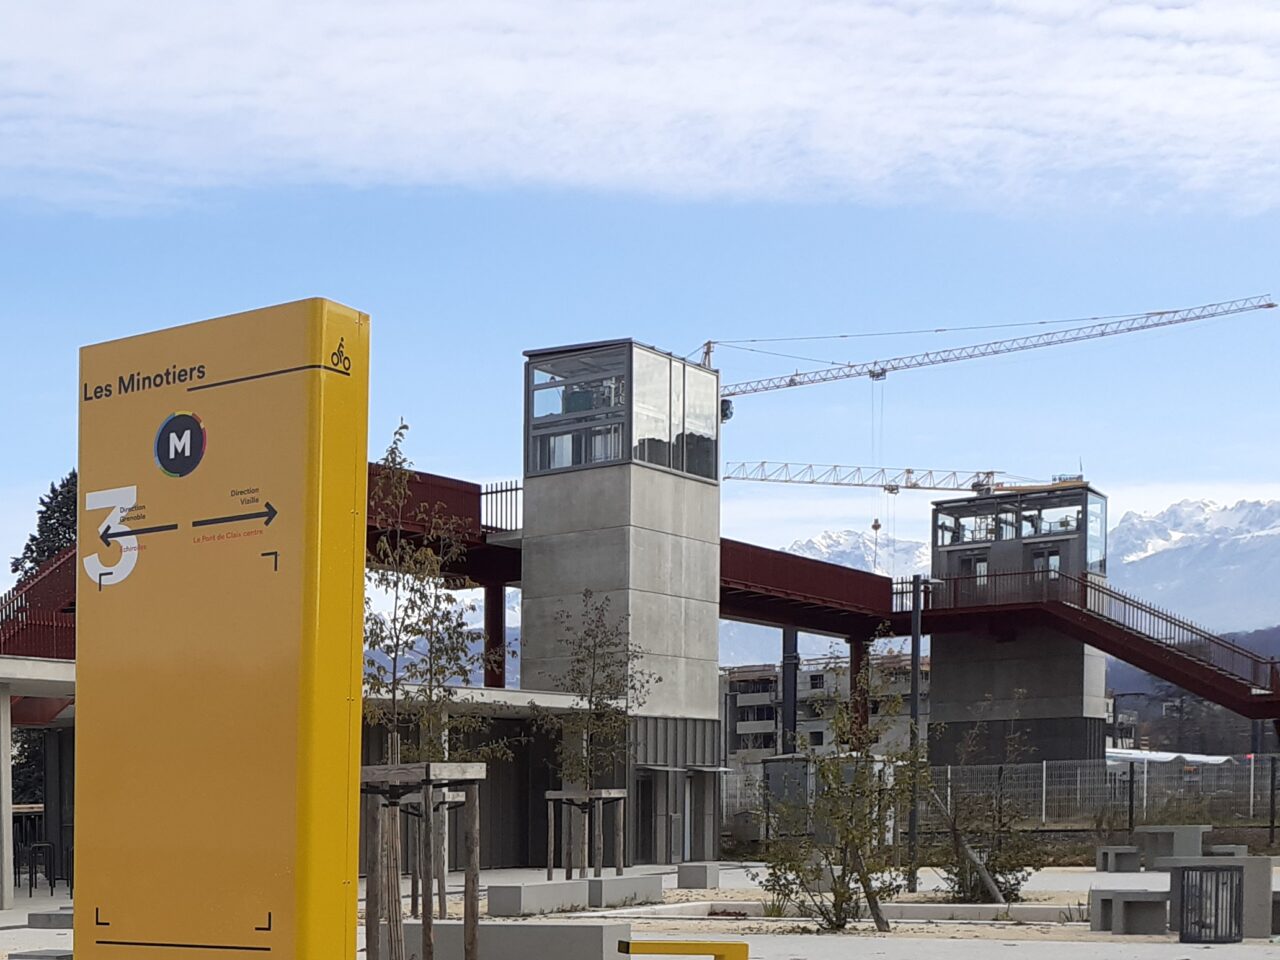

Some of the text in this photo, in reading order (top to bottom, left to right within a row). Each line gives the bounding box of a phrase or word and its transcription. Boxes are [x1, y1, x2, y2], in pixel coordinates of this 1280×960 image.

[83, 364, 206, 401] Les Minotiers
[168, 429, 192, 459] M
[230, 488, 260, 497] Direction
[240, 496, 260, 505] Vizille
[119, 504, 146, 513] Direction
[119, 513, 146, 522] Grenoble
[83, 485, 138, 585] 3
